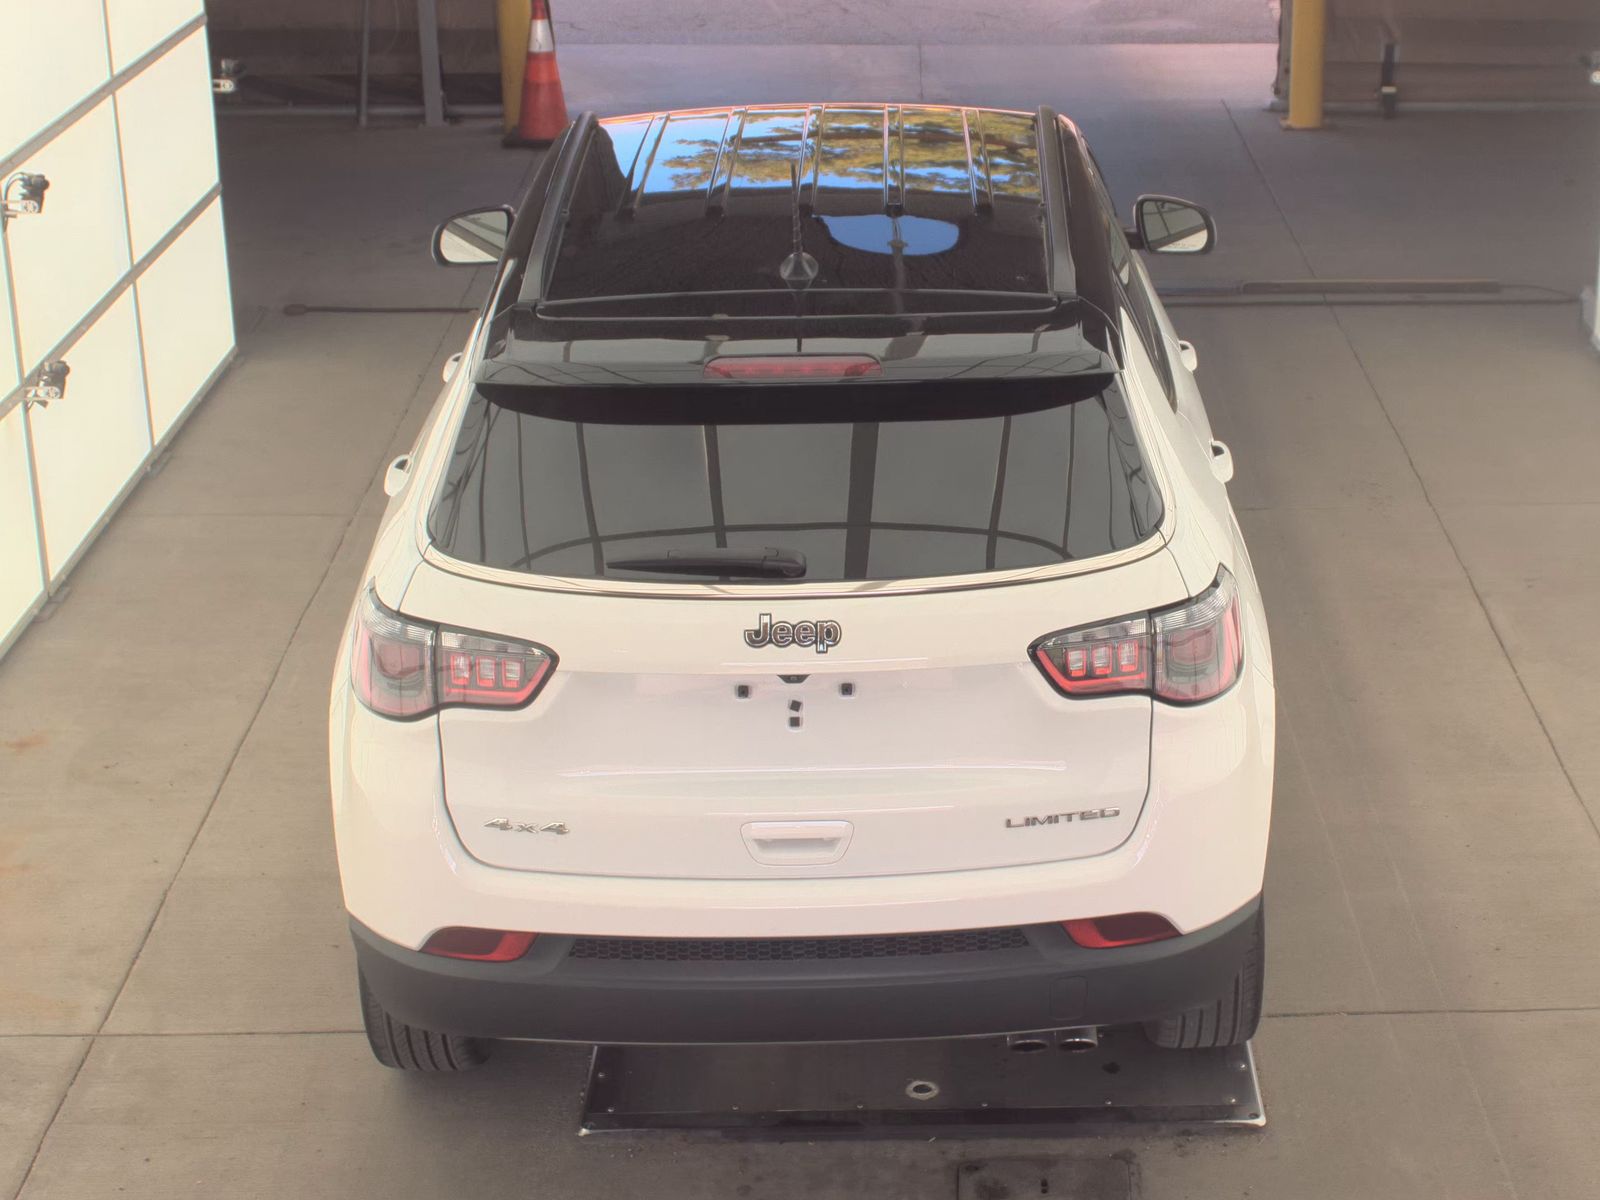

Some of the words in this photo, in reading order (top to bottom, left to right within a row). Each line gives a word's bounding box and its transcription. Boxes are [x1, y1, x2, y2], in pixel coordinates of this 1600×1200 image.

[744, 613, 842, 654] Jeep
[484, 817, 570, 835] 4x4
[1006, 807, 1120, 828] LIMITED
